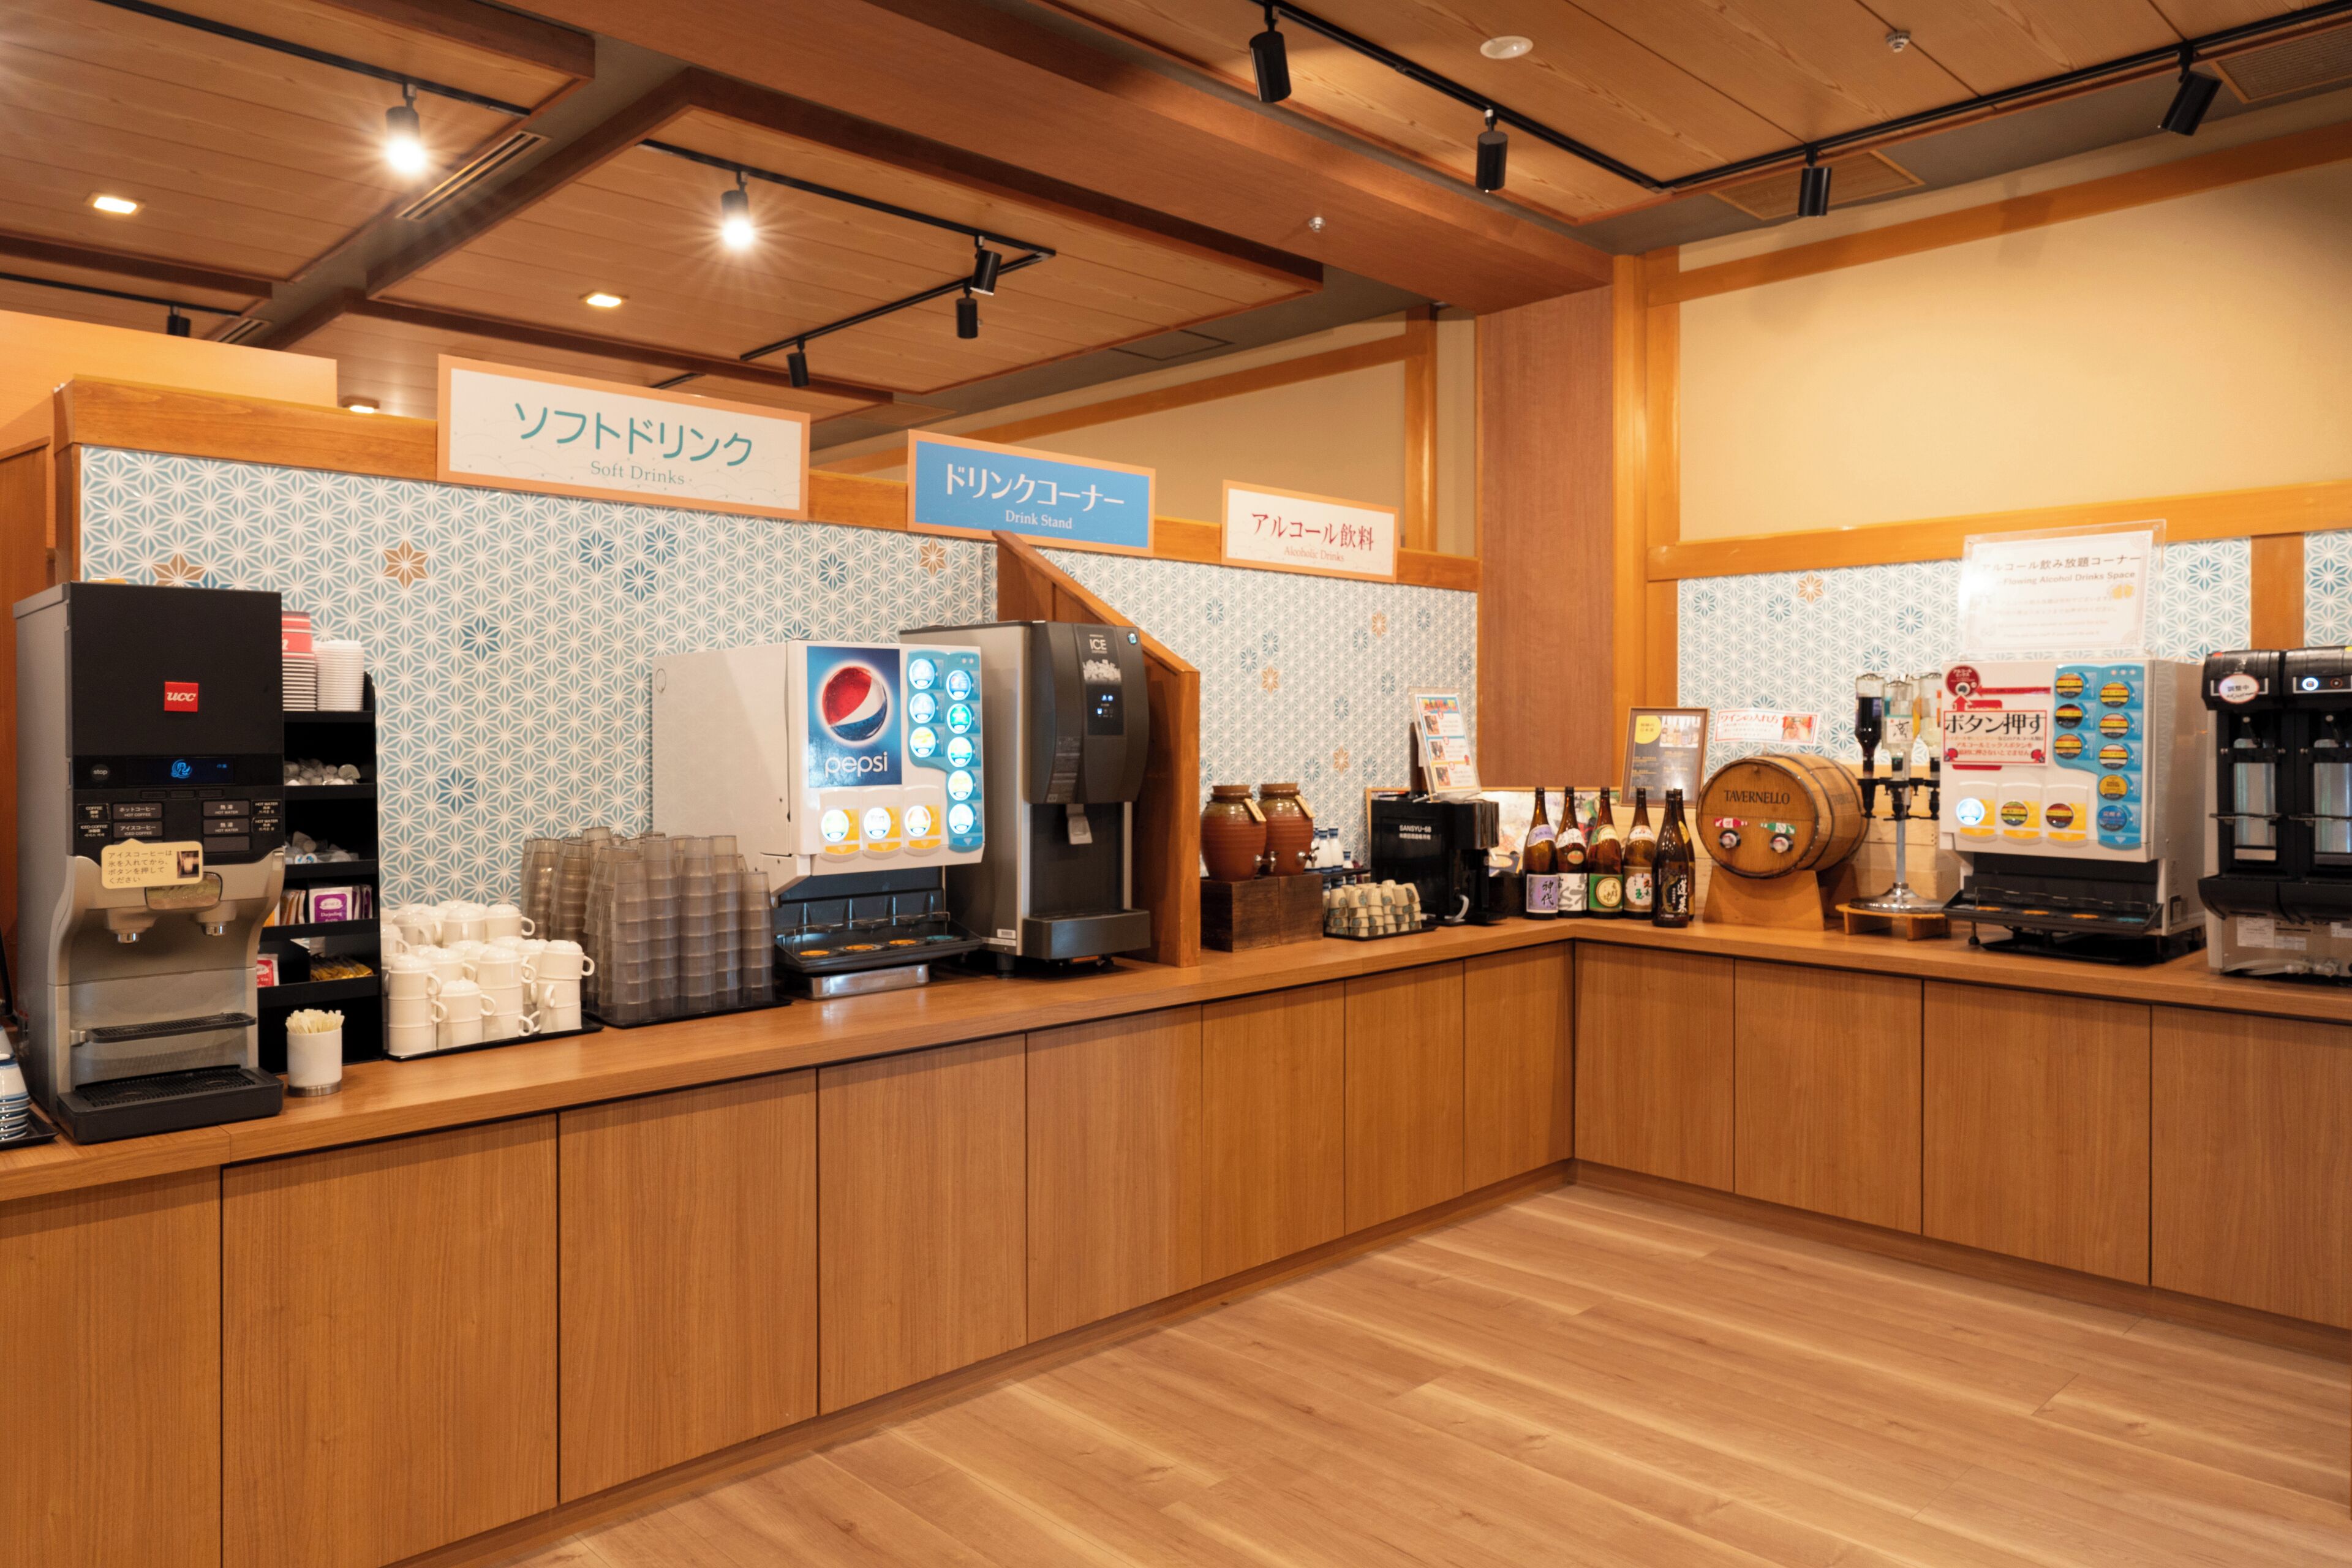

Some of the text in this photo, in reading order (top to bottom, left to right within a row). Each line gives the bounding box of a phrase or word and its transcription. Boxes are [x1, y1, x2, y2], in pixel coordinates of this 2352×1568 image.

[514, 402, 753, 466] ソフトドリンク
[590, 460, 685, 485] Soft Drinks
[946, 463, 1125, 512] ドリンクコーナー
[1005, 510, 1072, 530] Drink Stand
[1251, 512, 1374, 552] アルコール飲料
[1284, 546, 1345, 563] Alcoholic Drinks
[2040, 575, 2072, 583] Alcohol
[2075, 572, 2105, 581] Drinks
[2107, 570, 2135, 579] Space
[1089, 639, 1107, 650] ICE
[1945, 713, 2040, 734] ボタン押す
[825, 752, 888, 778] pepsi
[1724, 790, 1790, 805] TAVERNELLO
[108, 850, 172, 858] アイスコーヒーは
[108, 859, 168, 867] 氷を入れてから、
[108, 867, 165, 876] ボタンを押して
[1541, 880, 1555, 905] 神代
